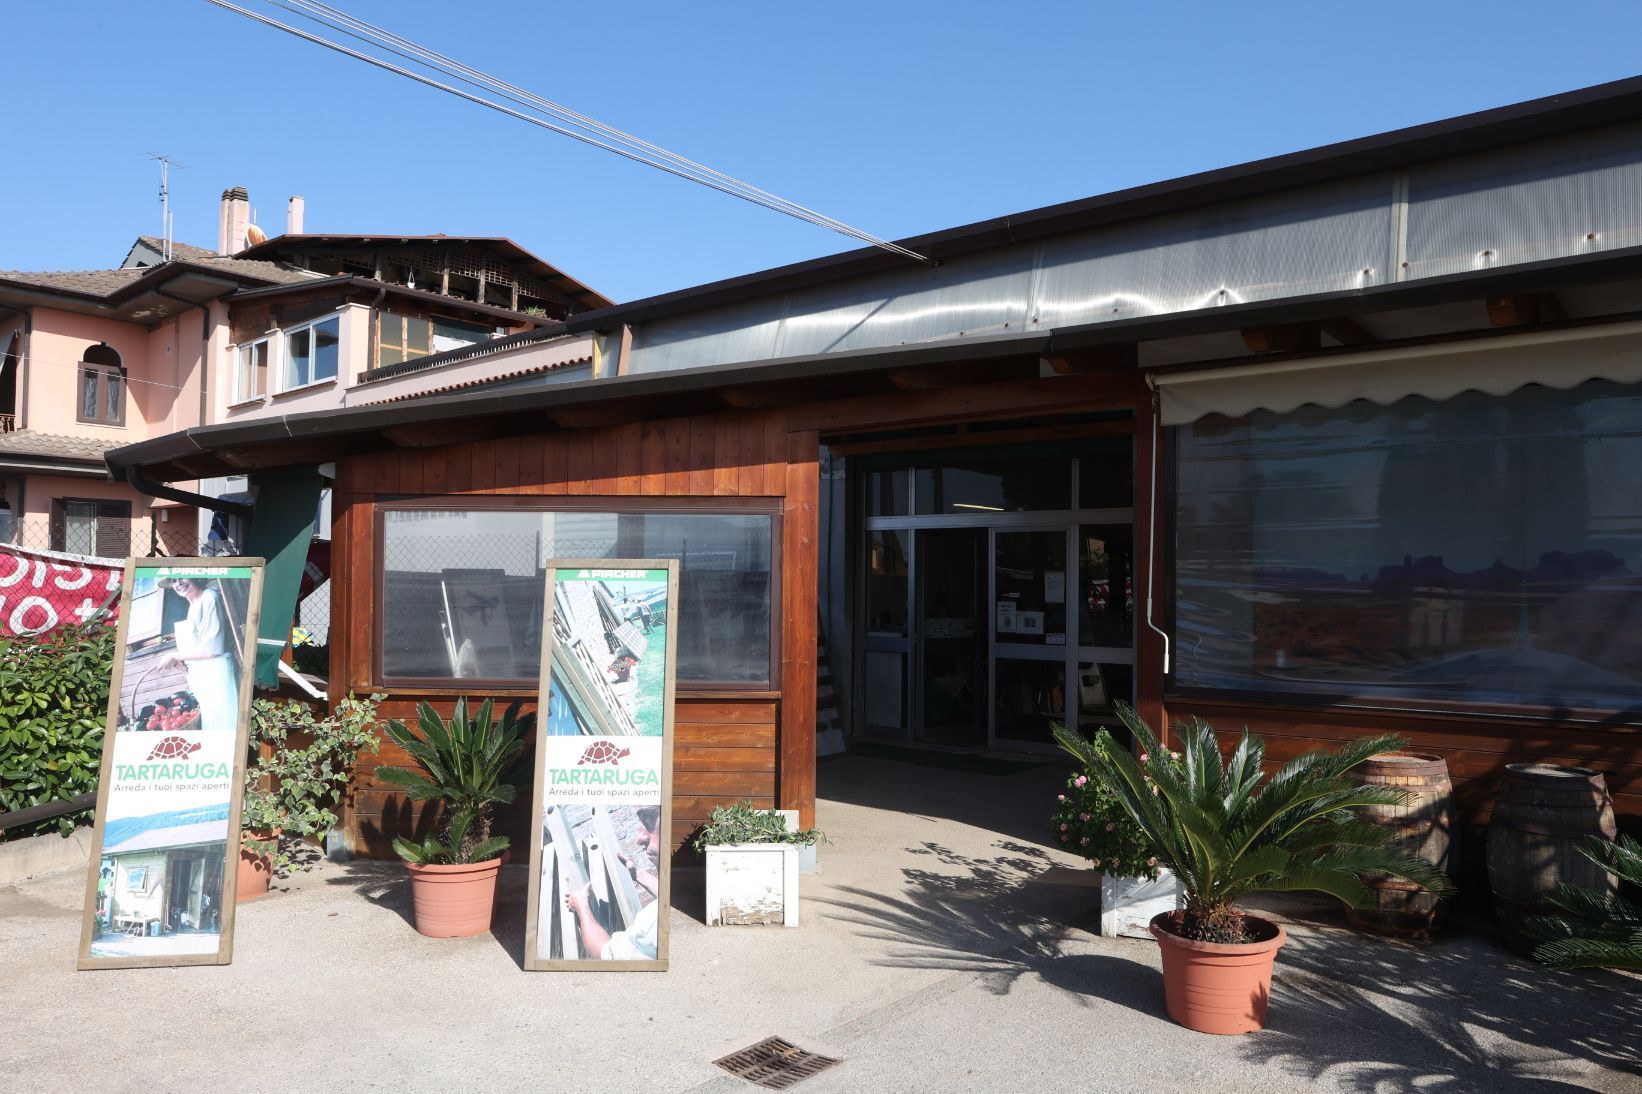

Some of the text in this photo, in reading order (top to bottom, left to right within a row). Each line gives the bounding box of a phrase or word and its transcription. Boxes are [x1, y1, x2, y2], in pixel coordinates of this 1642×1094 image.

[116, 762, 230, 781] TARTARUGA
[548, 768, 659, 785] TARTARUGA
[114, 784, 146, 792] Arreda
[154, 782, 173, 791] tuoi
[176, 782, 199, 793] spazi
[201, 782, 230, 791] aperti
[549, 787, 579, 796] Arreda
[587, 787, 605, 796] tuoi
[607, 787, 630, 798] spazi
[632, 787, 660, 798] aperti
